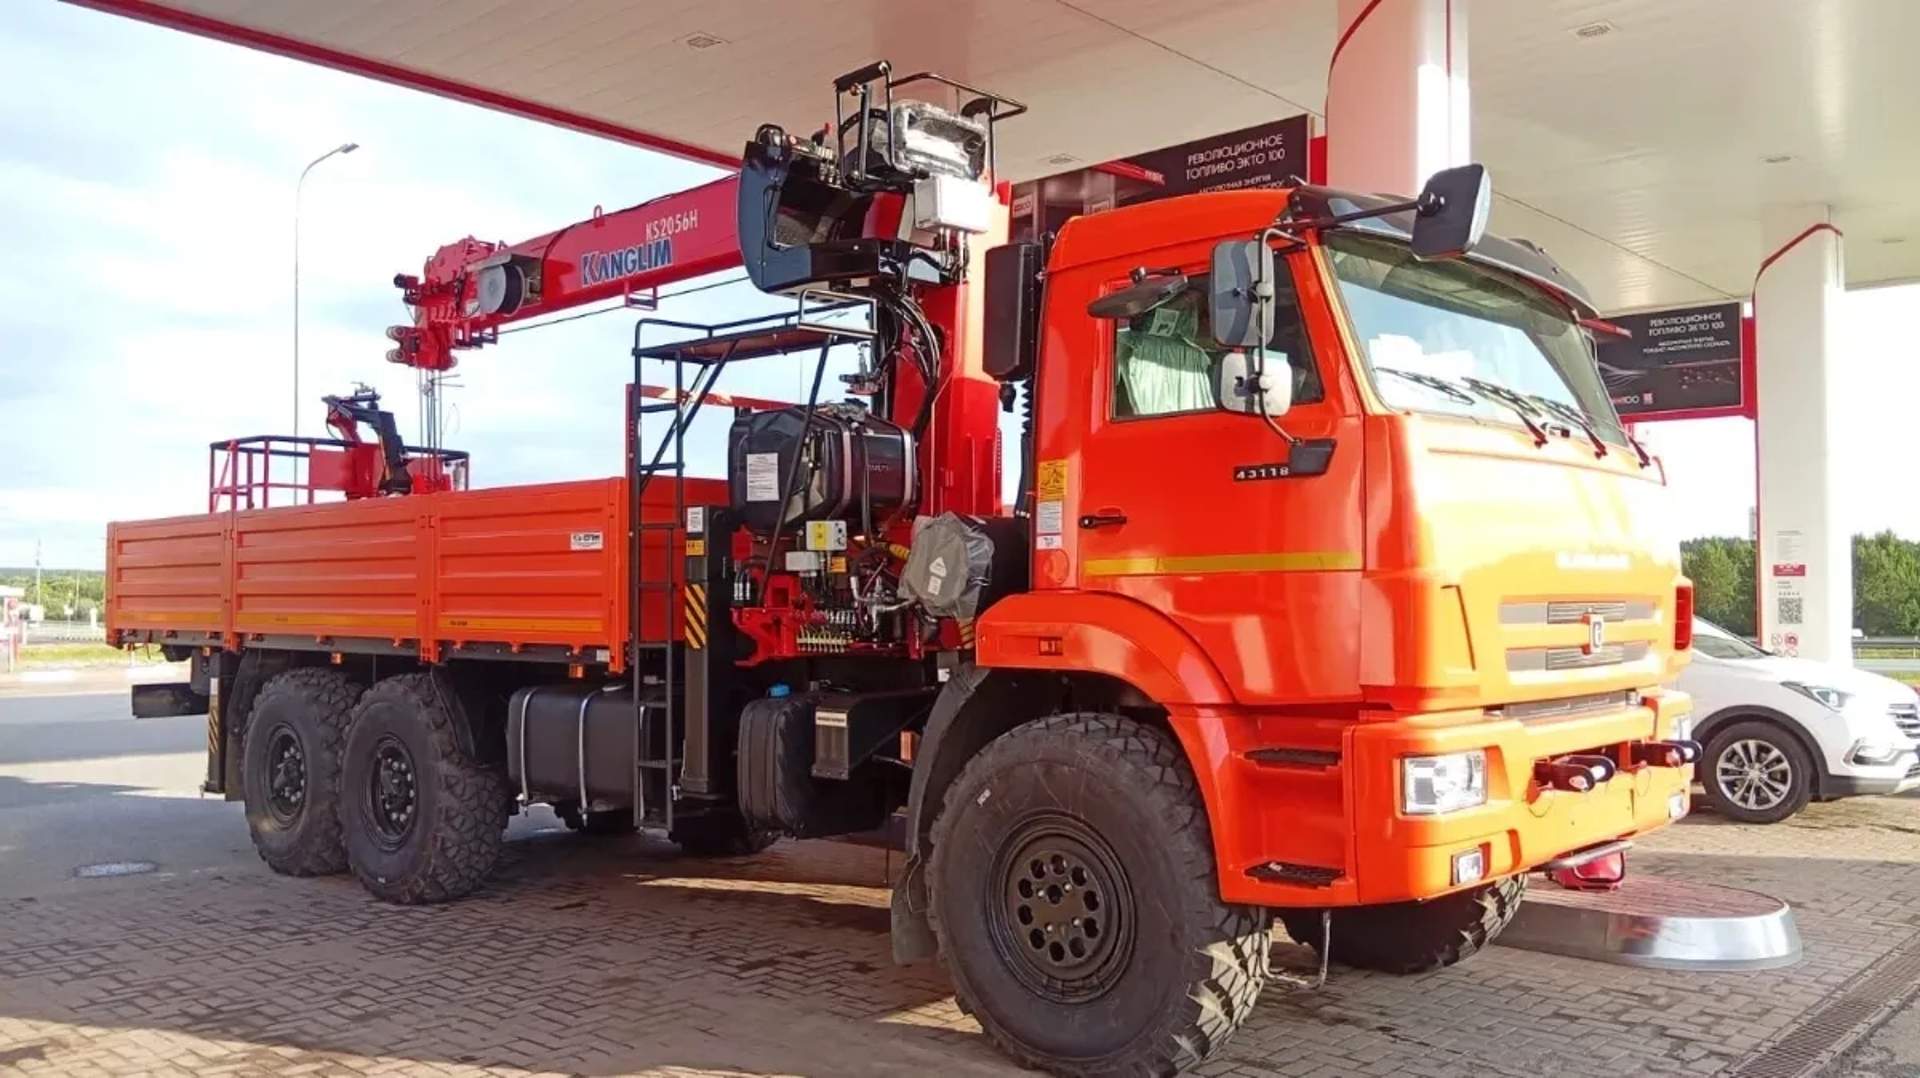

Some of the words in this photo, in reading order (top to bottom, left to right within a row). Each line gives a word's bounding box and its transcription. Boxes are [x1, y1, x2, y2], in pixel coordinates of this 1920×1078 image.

[1186, 159, 1235, 180] ТОПЛИВО
[1237, 153, 1265, 168] ЭКТО
[1268, 148, 1285, 160] 100
[1188, 134, 1283, 166] РЕВОЛЮЦИОННОЕ
[646, 209, 698, 240] KS2056H
[583, 237, 672, 287] KANGLIM
[1236, 466, 1289, 480] 43118
